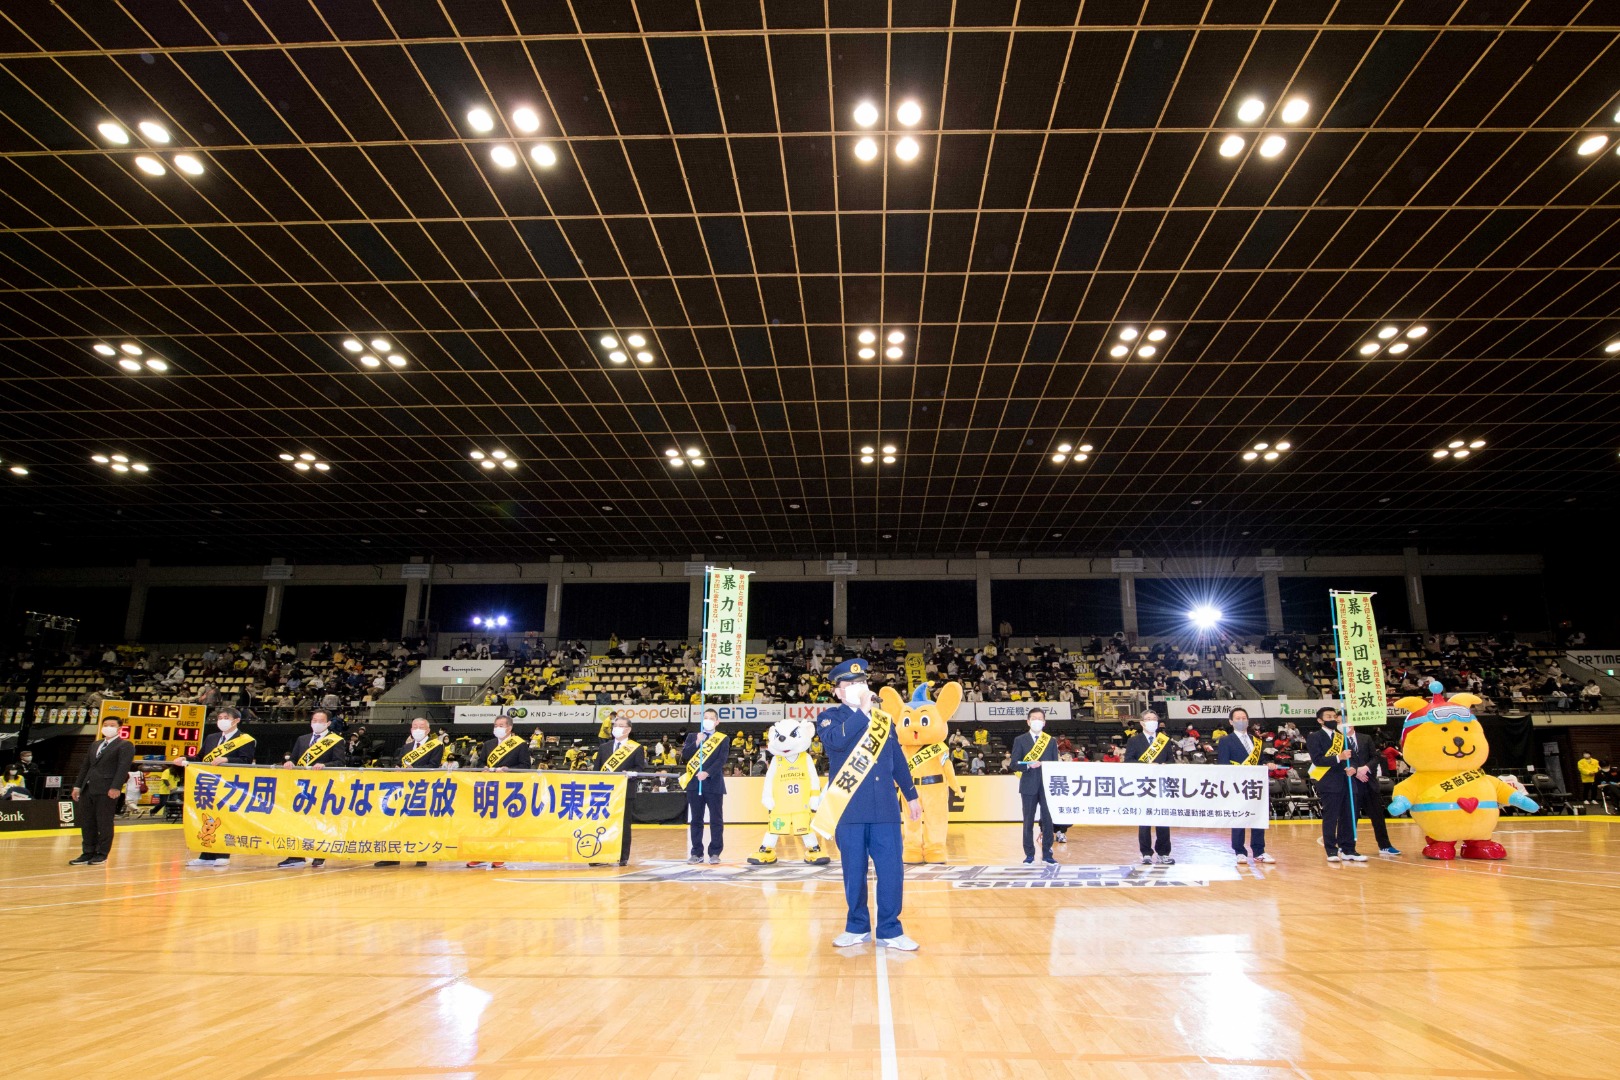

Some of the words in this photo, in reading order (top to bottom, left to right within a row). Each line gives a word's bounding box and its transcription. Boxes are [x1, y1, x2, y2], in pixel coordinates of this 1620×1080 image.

[716, 574, 737, 678] 暴力団追放
[1347, 597, 1377, 709] 暴力団追放
[1577, 655, 1594, 665] PR
[442, 665, 482, 674] Champion
[137, 704, 179, 718] 11:12
[147, 728, 157, 739] 2
[178, 729, 199, 740] 41
[171, 747, 179, 756] 3
[188, 746, 197, 757] 0
[836, 710, 889, 794] 暴力団追放
[787, 784, 800, 795] 36
[1048, 775, 1264, 801] 暴力団と交際しない街
[193, 772, 278, 815] 暴力団
[292, 778, 458, 818] みんなで追放
[472, 780, 615, 821] 明るい東京
